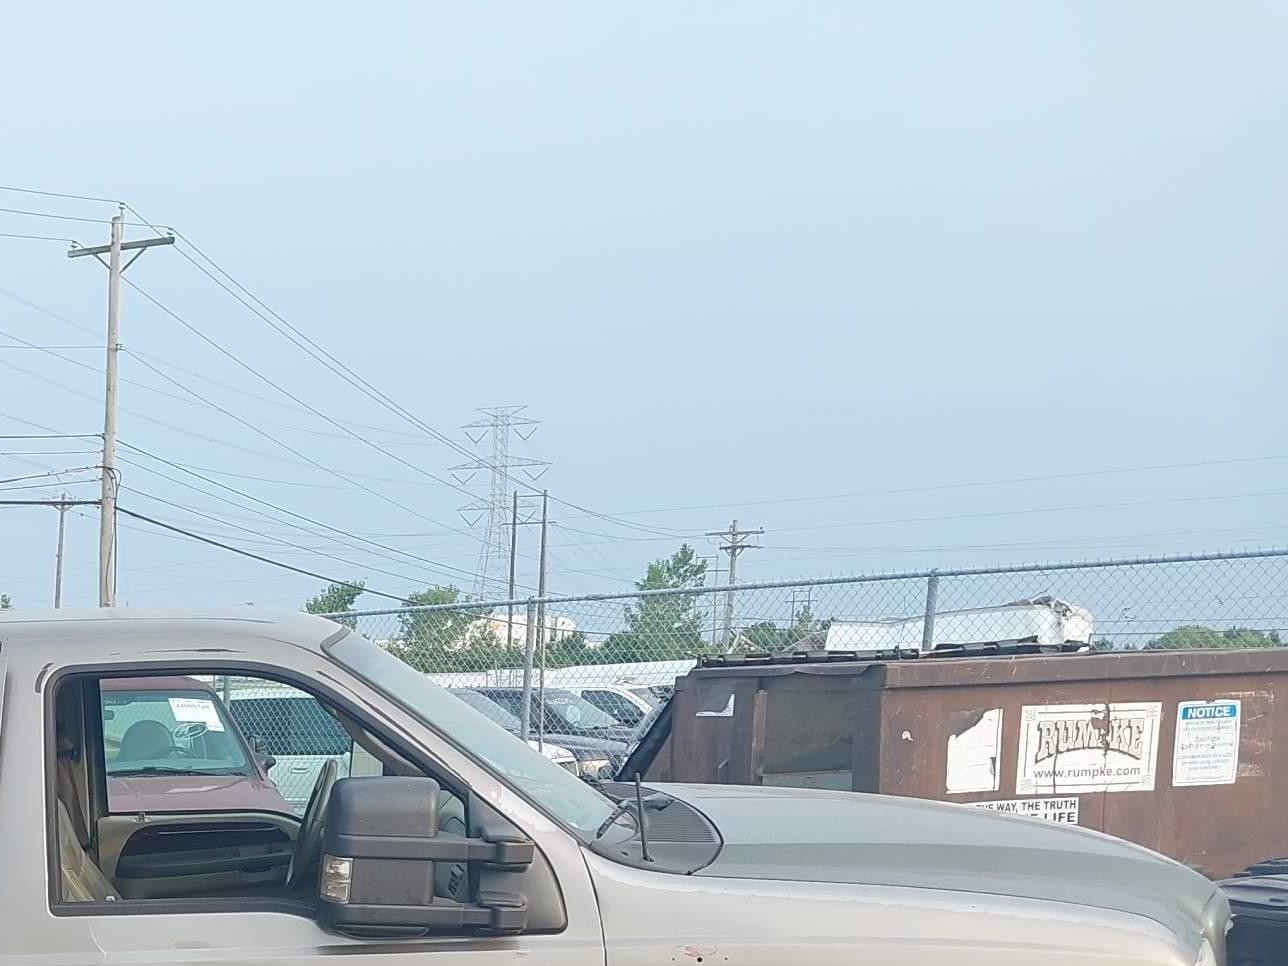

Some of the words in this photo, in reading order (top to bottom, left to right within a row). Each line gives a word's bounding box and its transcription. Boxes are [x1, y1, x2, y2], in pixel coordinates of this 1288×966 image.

[1187, 706, 1231, 718] NOTICE
[1033, 767, 1141, 780] www.rumpke.com
[1021, 801, 1041, 811] THE
[1043, 799, 1076, 810] TRUTH
